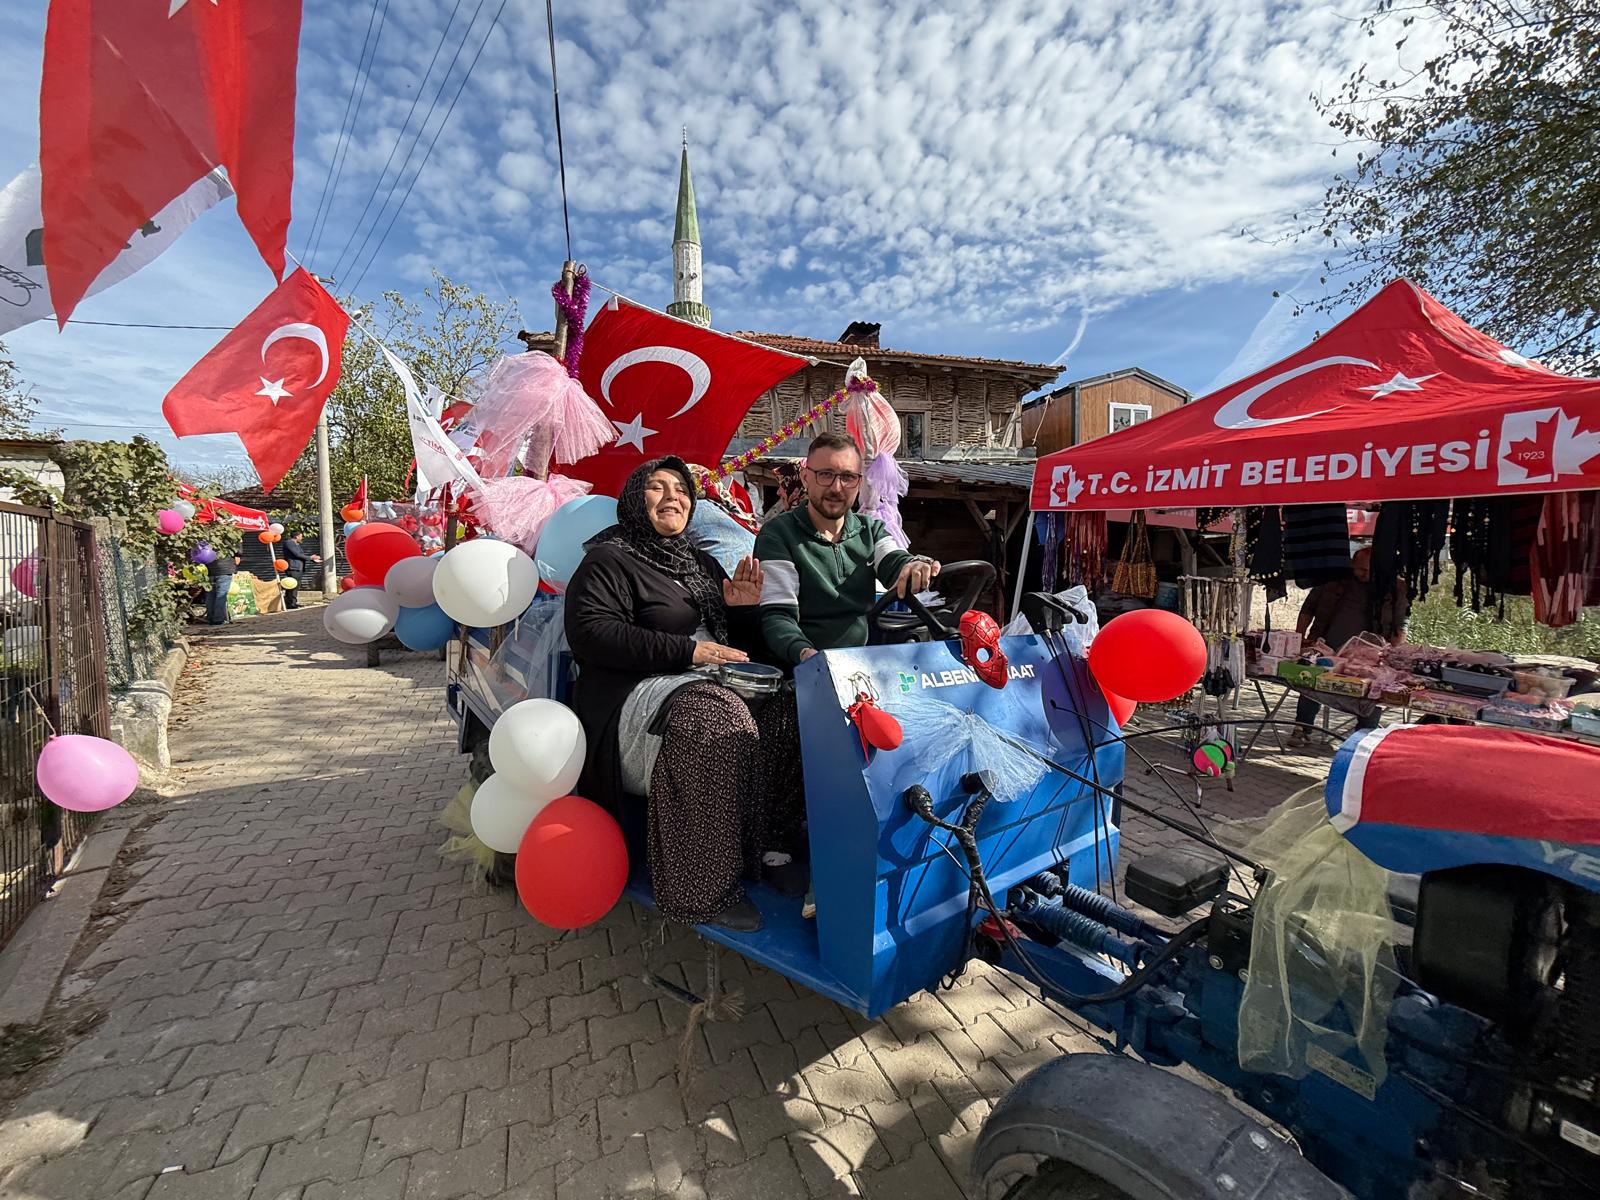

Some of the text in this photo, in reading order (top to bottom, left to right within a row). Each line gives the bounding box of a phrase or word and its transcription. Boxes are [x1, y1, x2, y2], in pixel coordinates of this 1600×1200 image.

[1087, 429, 1491, 495] T.C. İZMİT BELEDİYESİ
[1517, 450, 1545, 461] 1923
[921, 665, 980, 689] ALBEN
